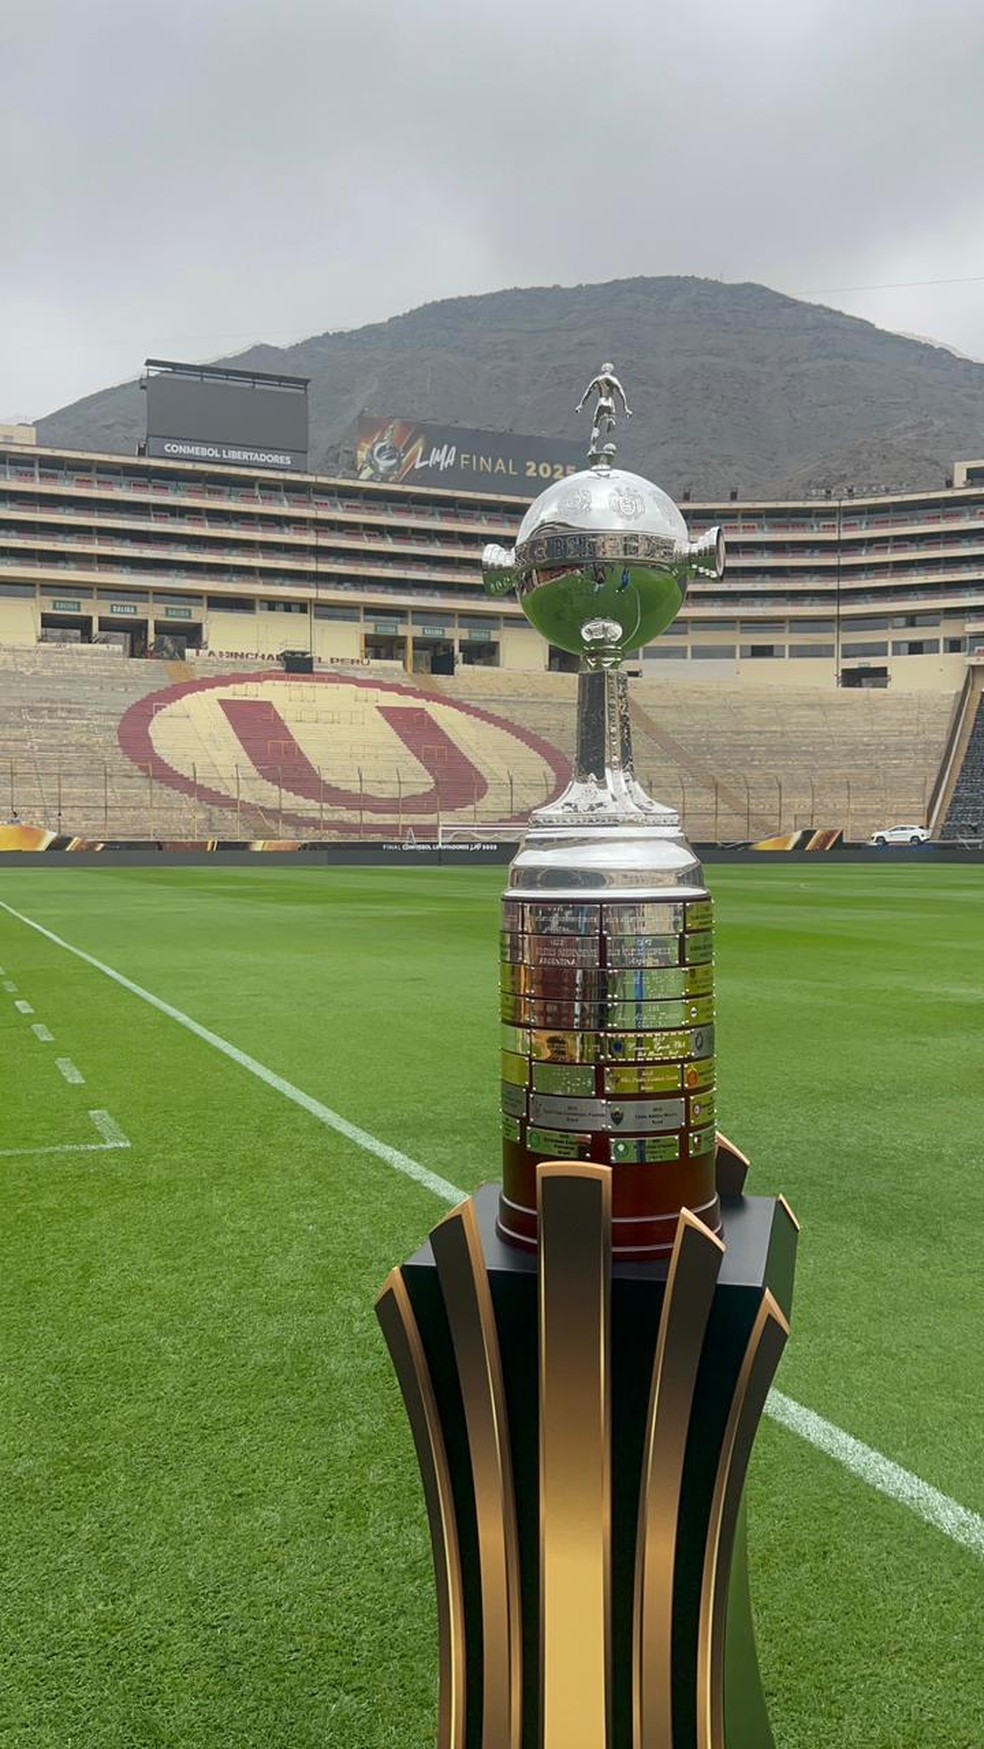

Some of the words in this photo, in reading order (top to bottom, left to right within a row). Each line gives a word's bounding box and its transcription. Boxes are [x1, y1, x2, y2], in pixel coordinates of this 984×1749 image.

[164, 443, 220, 458] CONMEBOL
[222, 449, 292, 465] LIBERTADORES
[414, 444, 457, 471] LIMA
[460, 454, 518, 476] FINAL
[525, 461, 577, 480] 2025
